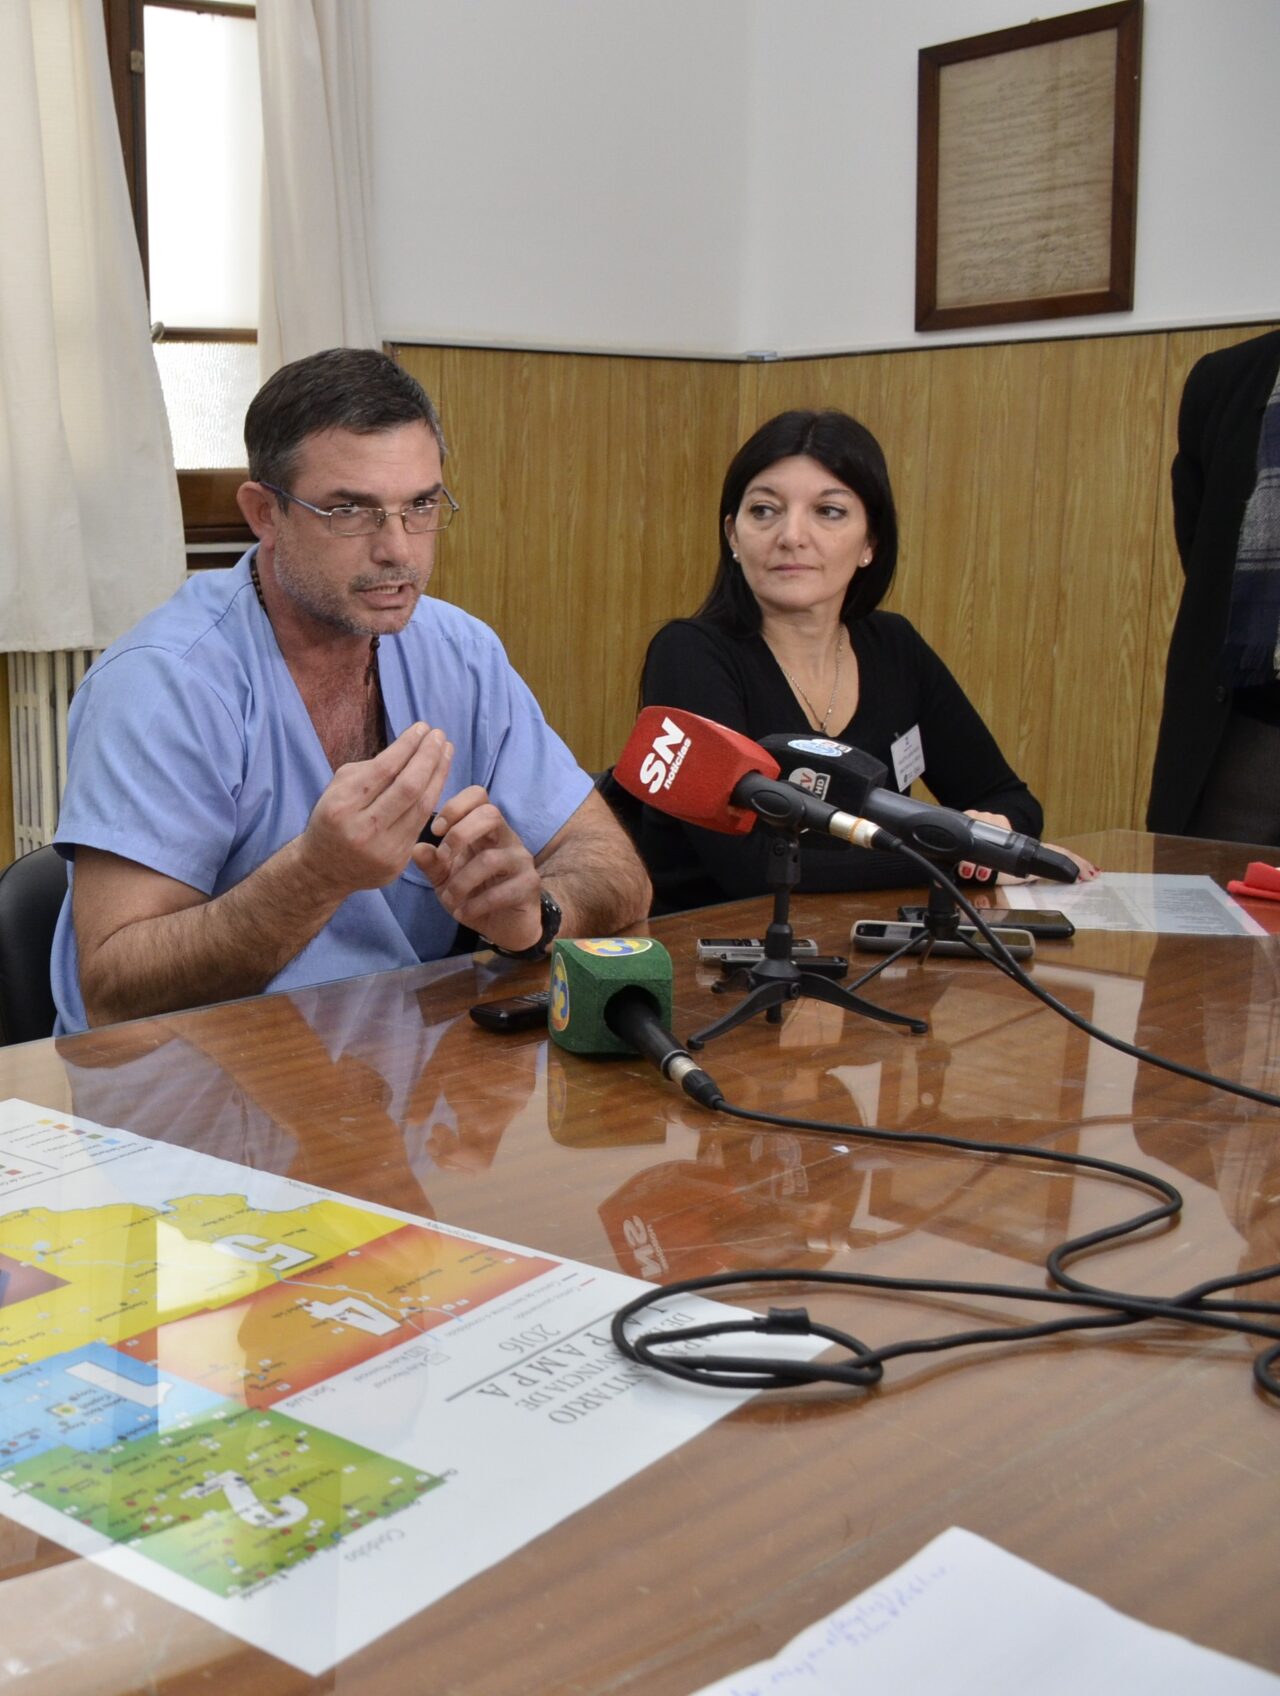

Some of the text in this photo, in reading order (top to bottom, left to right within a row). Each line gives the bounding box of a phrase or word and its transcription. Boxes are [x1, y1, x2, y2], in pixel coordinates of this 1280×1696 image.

[640, 716, 685, 794] SN
[664, 737, 692, 790] noticias
[815, 779, 825, 794] HD
[499, 1323, 561, 1353] 2016
[478, 1331, 614, 1399] PAMPA
[541, 1350, 626, 1394] OVINCIA
[549, 1362, 652, 1424] NITARIO
